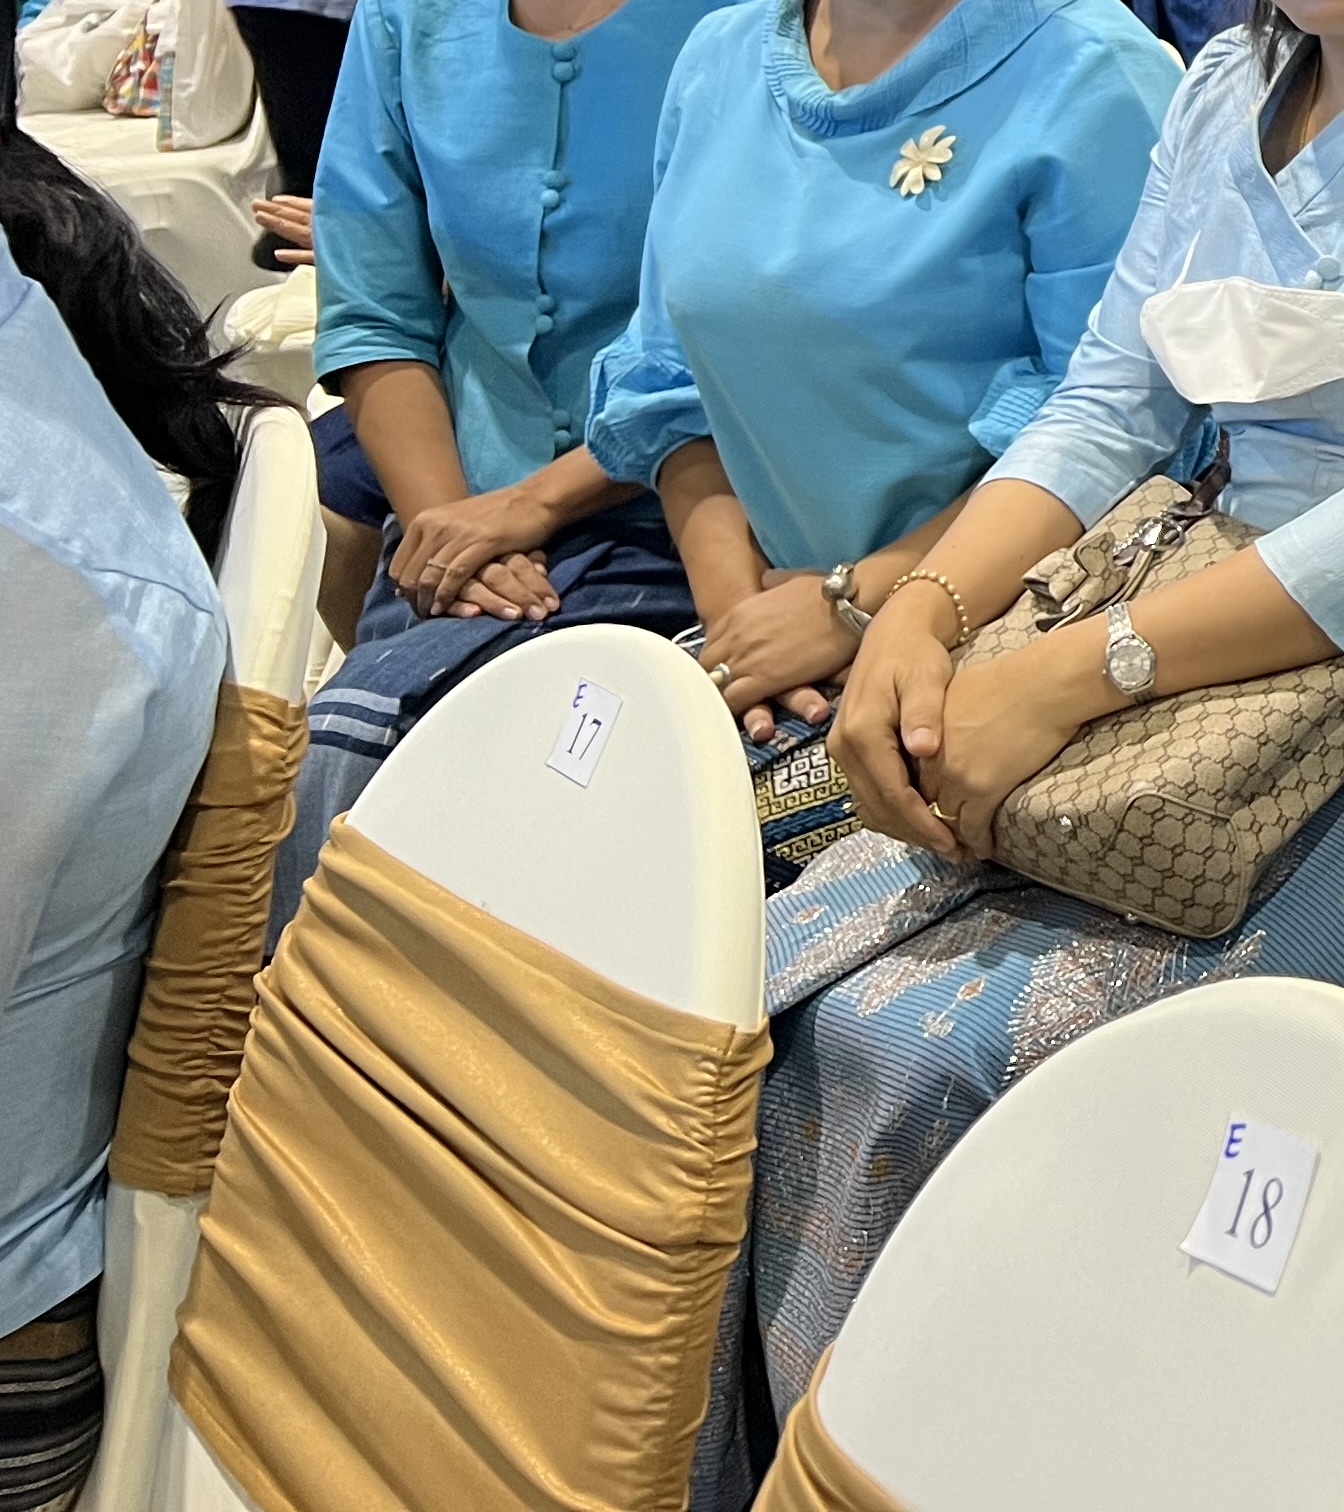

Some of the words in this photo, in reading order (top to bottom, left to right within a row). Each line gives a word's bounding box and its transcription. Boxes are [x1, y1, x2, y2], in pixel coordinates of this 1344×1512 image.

[566, 712, 602, 761] 17
[1223, 1122, 1248, 1159] E
[1223, 1167, 1284, 1250] 18
